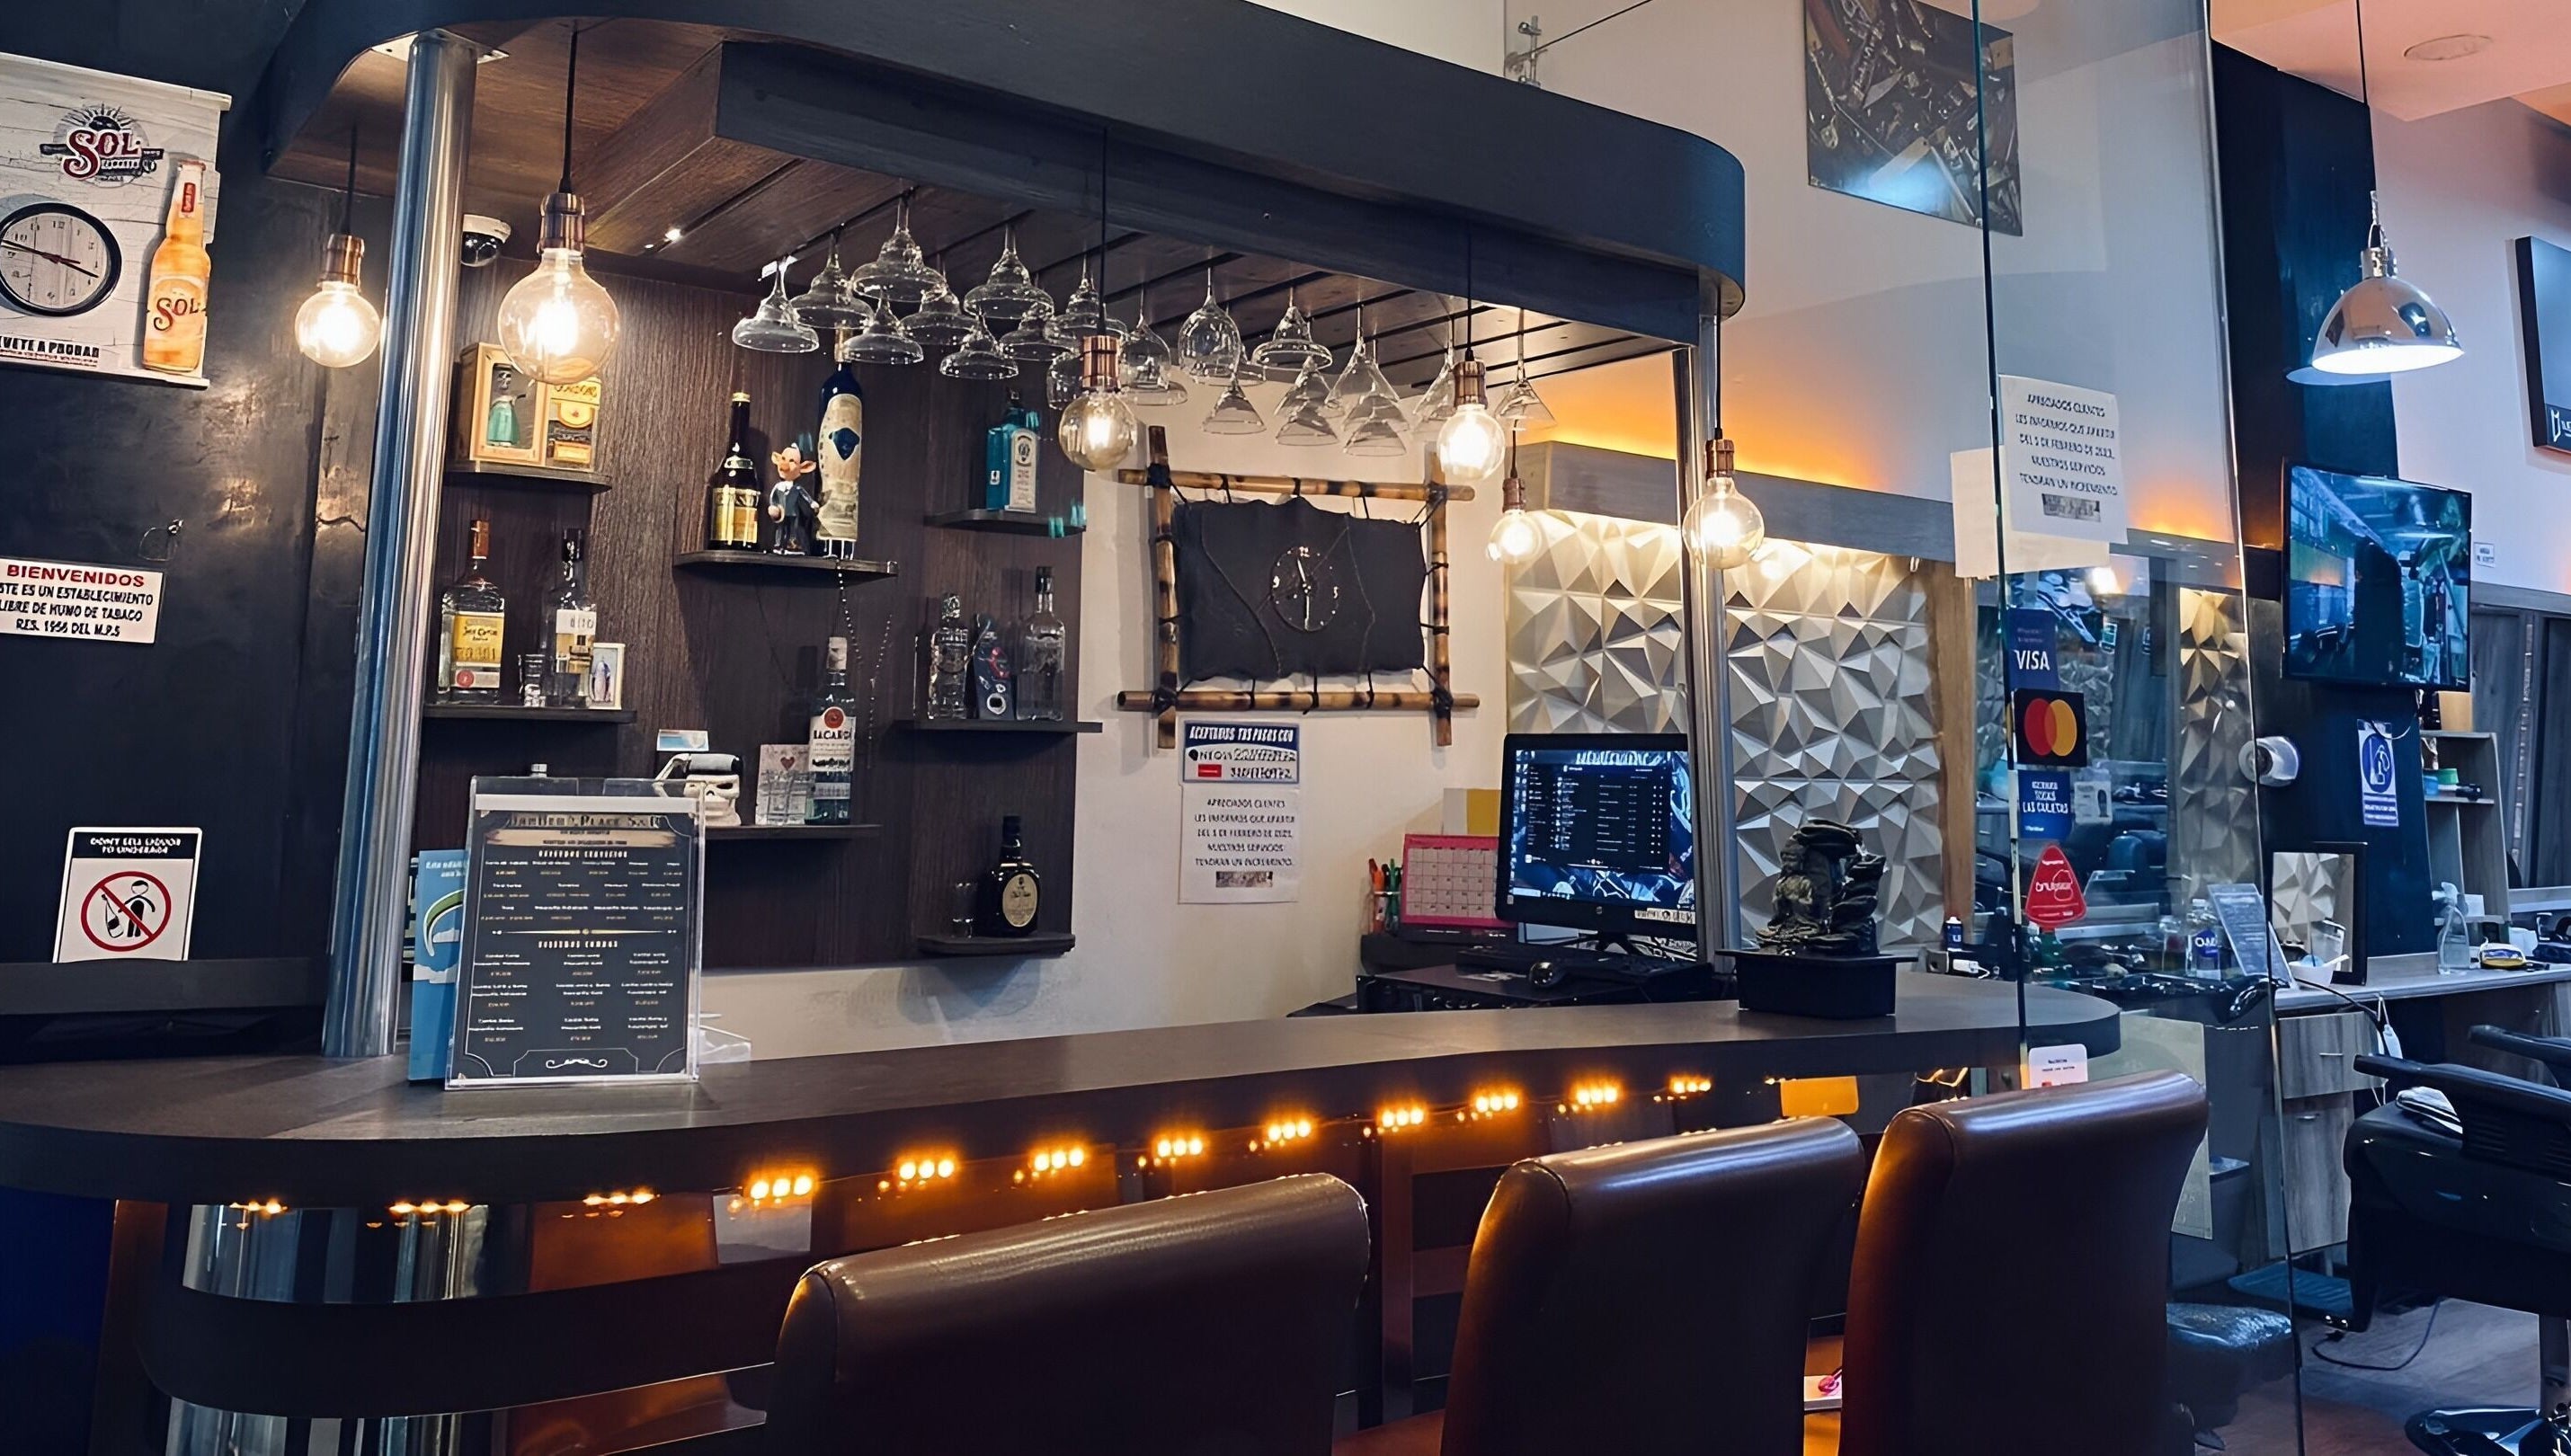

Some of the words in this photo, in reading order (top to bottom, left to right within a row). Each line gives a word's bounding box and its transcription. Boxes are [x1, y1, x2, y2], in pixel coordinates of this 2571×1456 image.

[7, 564, 145, 587] BIENVENIDOS
[22, 584, 35, 596] ES
[39, 585, 54, 598] UN
[57, 587, 153, 606] ESTABLECIMIENTO
[32, 602, 46, 615] DE
[49, 603, 82, 617] HUMO
[85, 606, 99, 618] DE
[102, 608, 143, 622] TABACO
[71, 623, 90, 635] DEL
[2014, 649, 2051, 670] VISA
